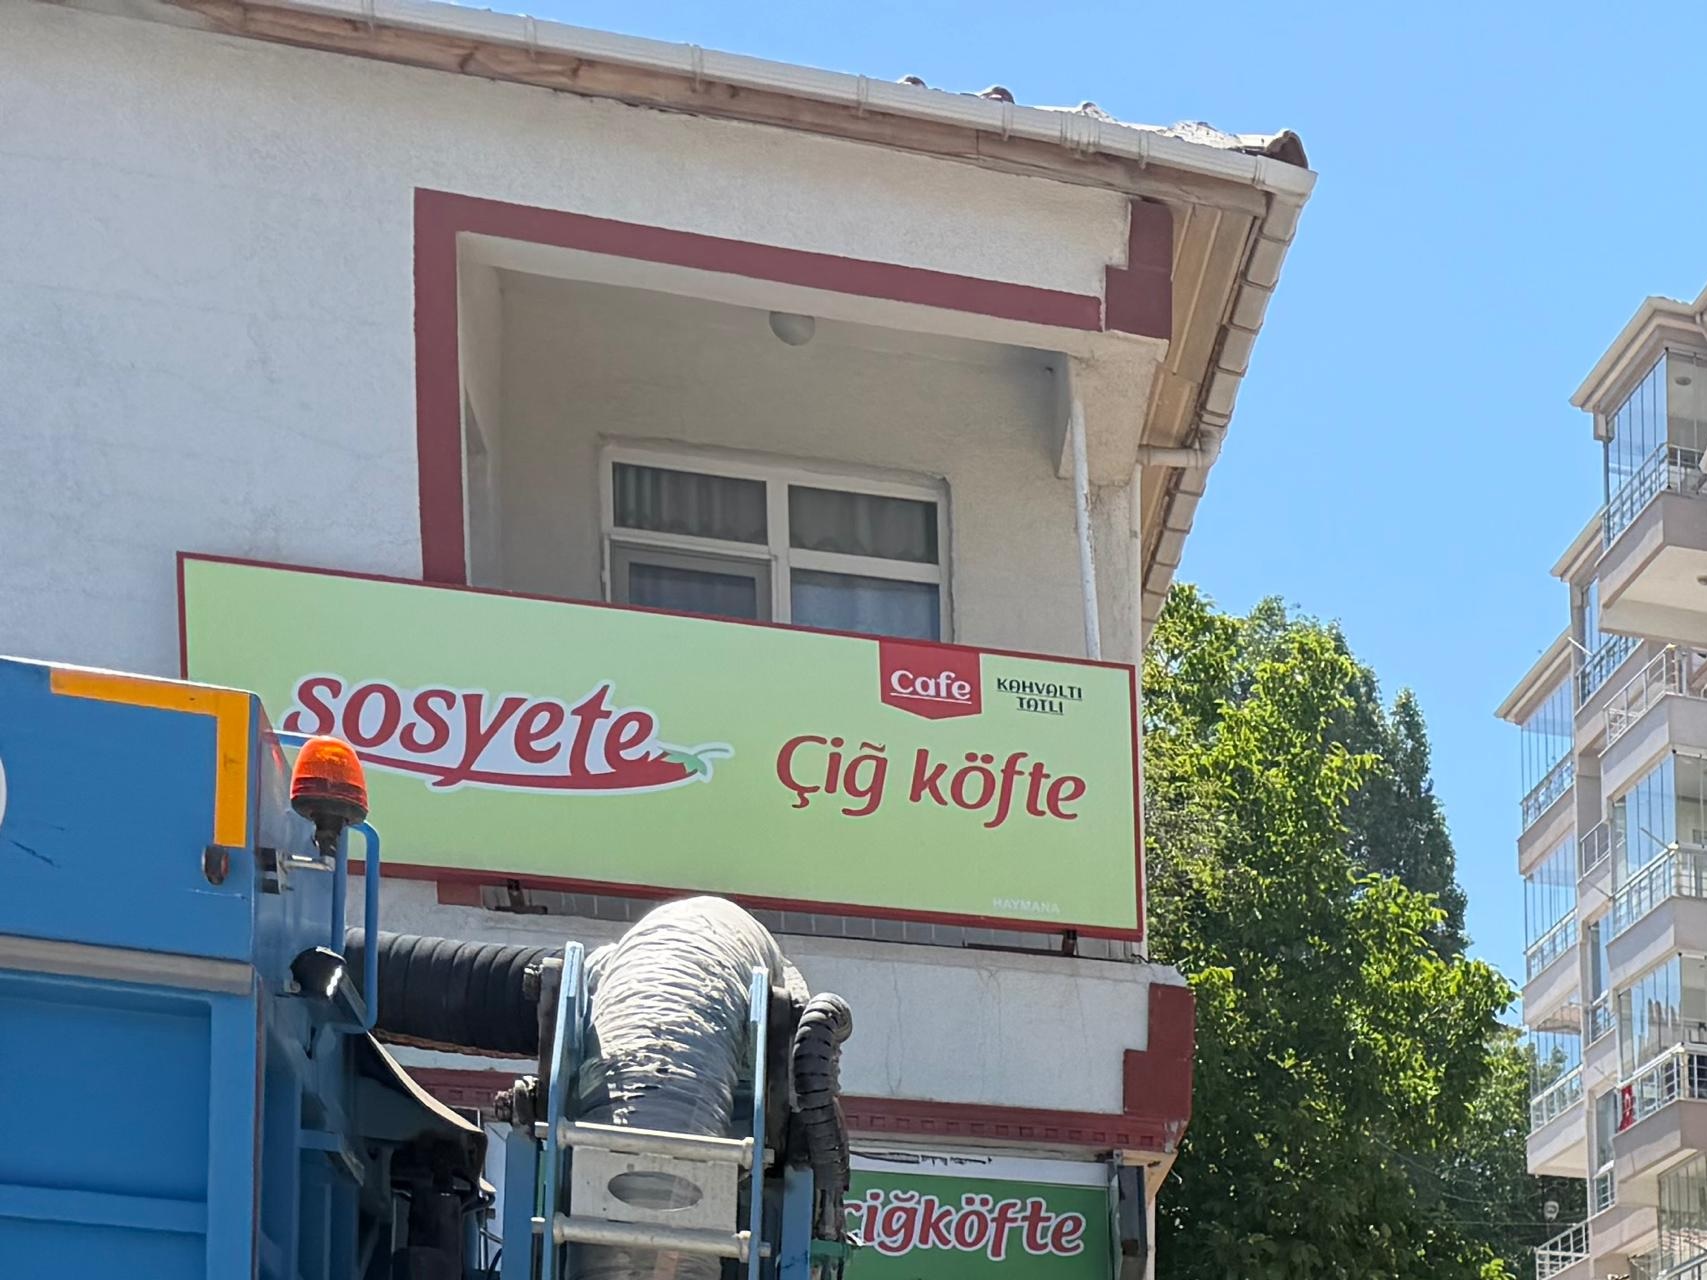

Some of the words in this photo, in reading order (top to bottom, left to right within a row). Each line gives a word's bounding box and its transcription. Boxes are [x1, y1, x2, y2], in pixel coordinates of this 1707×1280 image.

[890, 669, 972, 700] Cafe
[996, 677, 1083, 699] KAHVALTI
[1016, 696, 1063, 714] TATLI
[282, 676, 655, 787] sosyete
[775, 734, 889, 818] Çiğ
[909, 747, 1087, 829] köfte
[992, 896, 1061, 915] HAYMANA
